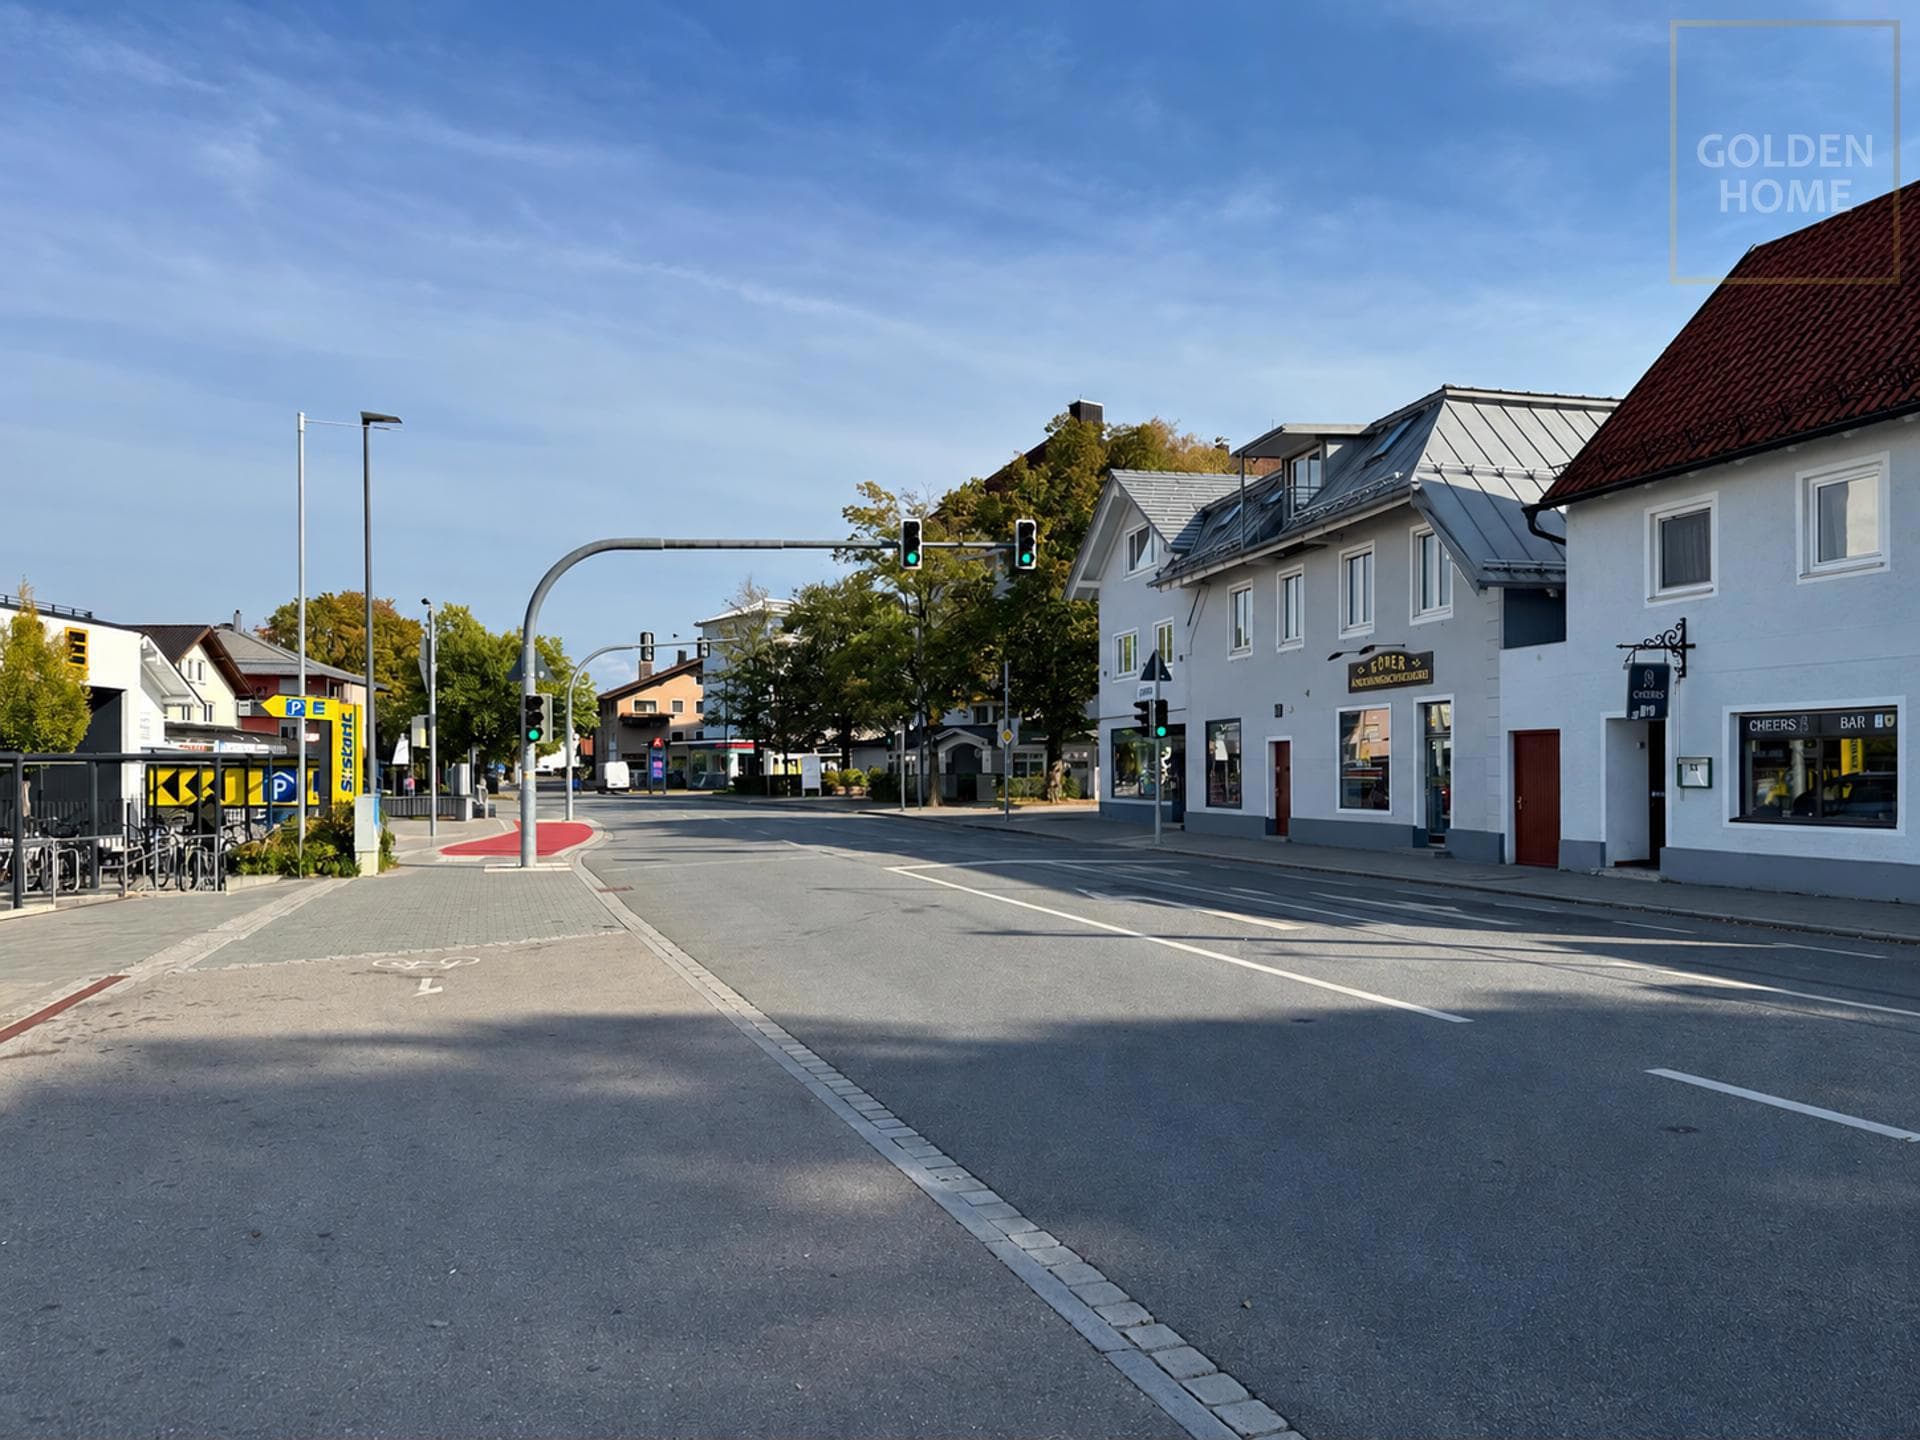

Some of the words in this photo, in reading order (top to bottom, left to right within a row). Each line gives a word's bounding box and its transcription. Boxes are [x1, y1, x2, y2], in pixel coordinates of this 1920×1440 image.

[1749, 718, 1797, 732] CHEERS
[1840, 715, 1866, 729] BAR
[273, 779, 287, 801] P
